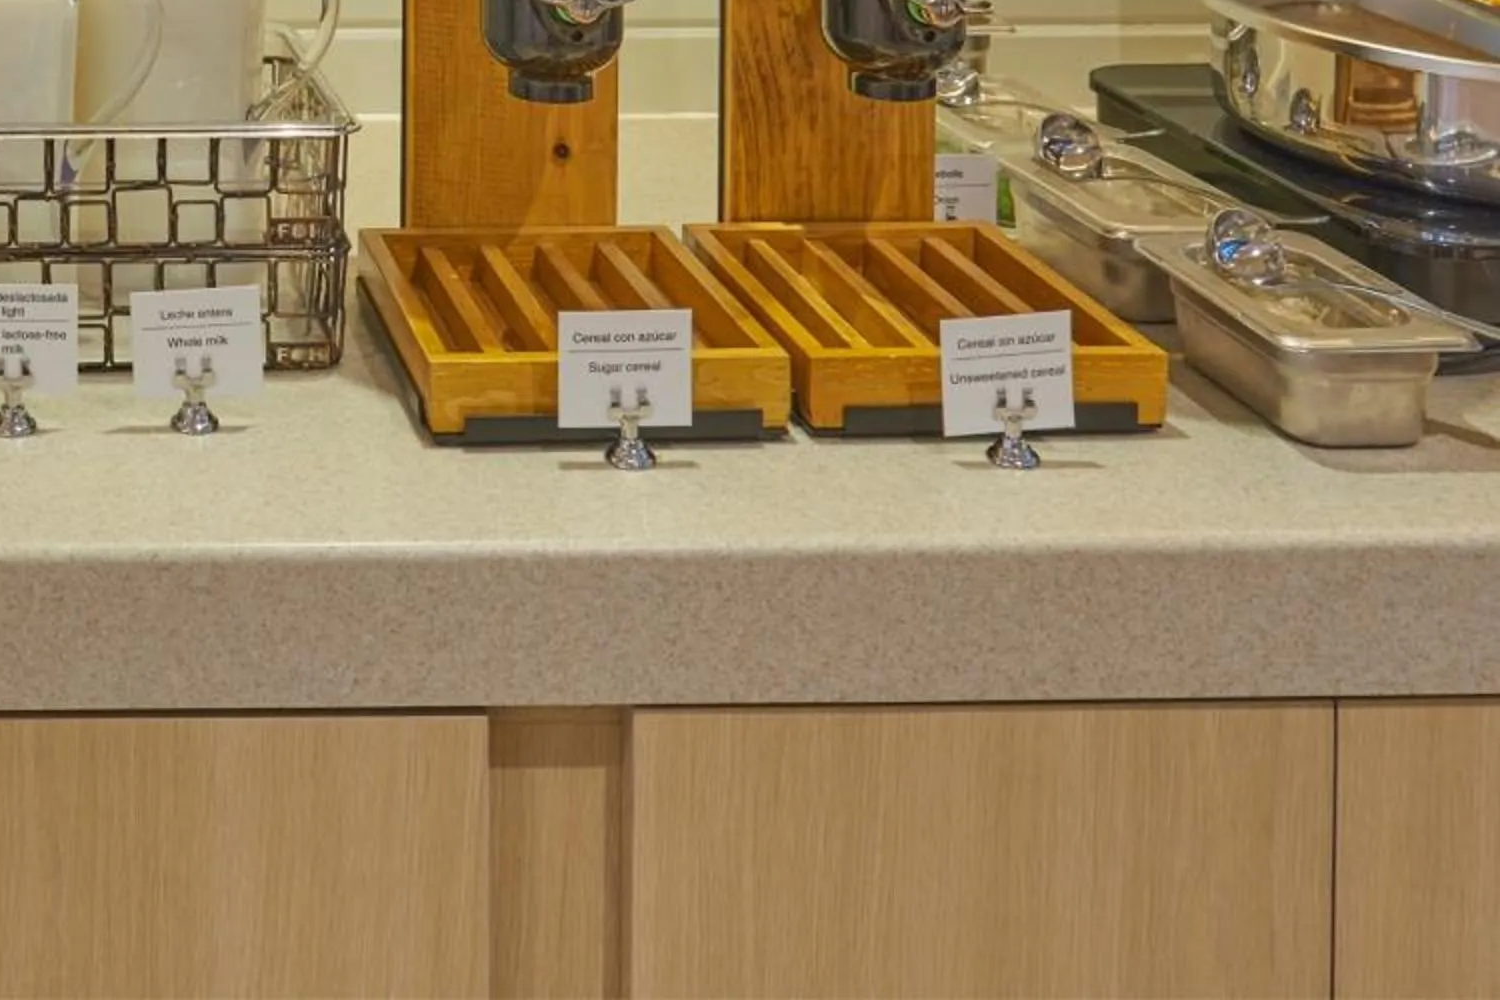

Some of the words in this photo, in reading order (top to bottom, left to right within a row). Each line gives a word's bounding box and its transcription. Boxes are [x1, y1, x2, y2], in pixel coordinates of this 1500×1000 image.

[160, 311, 195, 321] Leche
[167, 336, 203, 349] Whole
[206, 335, 228, 346] milk
[572, 331, 611, 344] Cereal
[613, 332, 635, 343] con
[957, 336, 996, 350] Cereal
[1, 343, 24, 354] milk
[588, 361, 621, 376] Sugar
[625, 361, 661, 373] cereal
[949, 369, 1029, 385] Unsweetened
[1031, 365, 1066, 378] cereal
